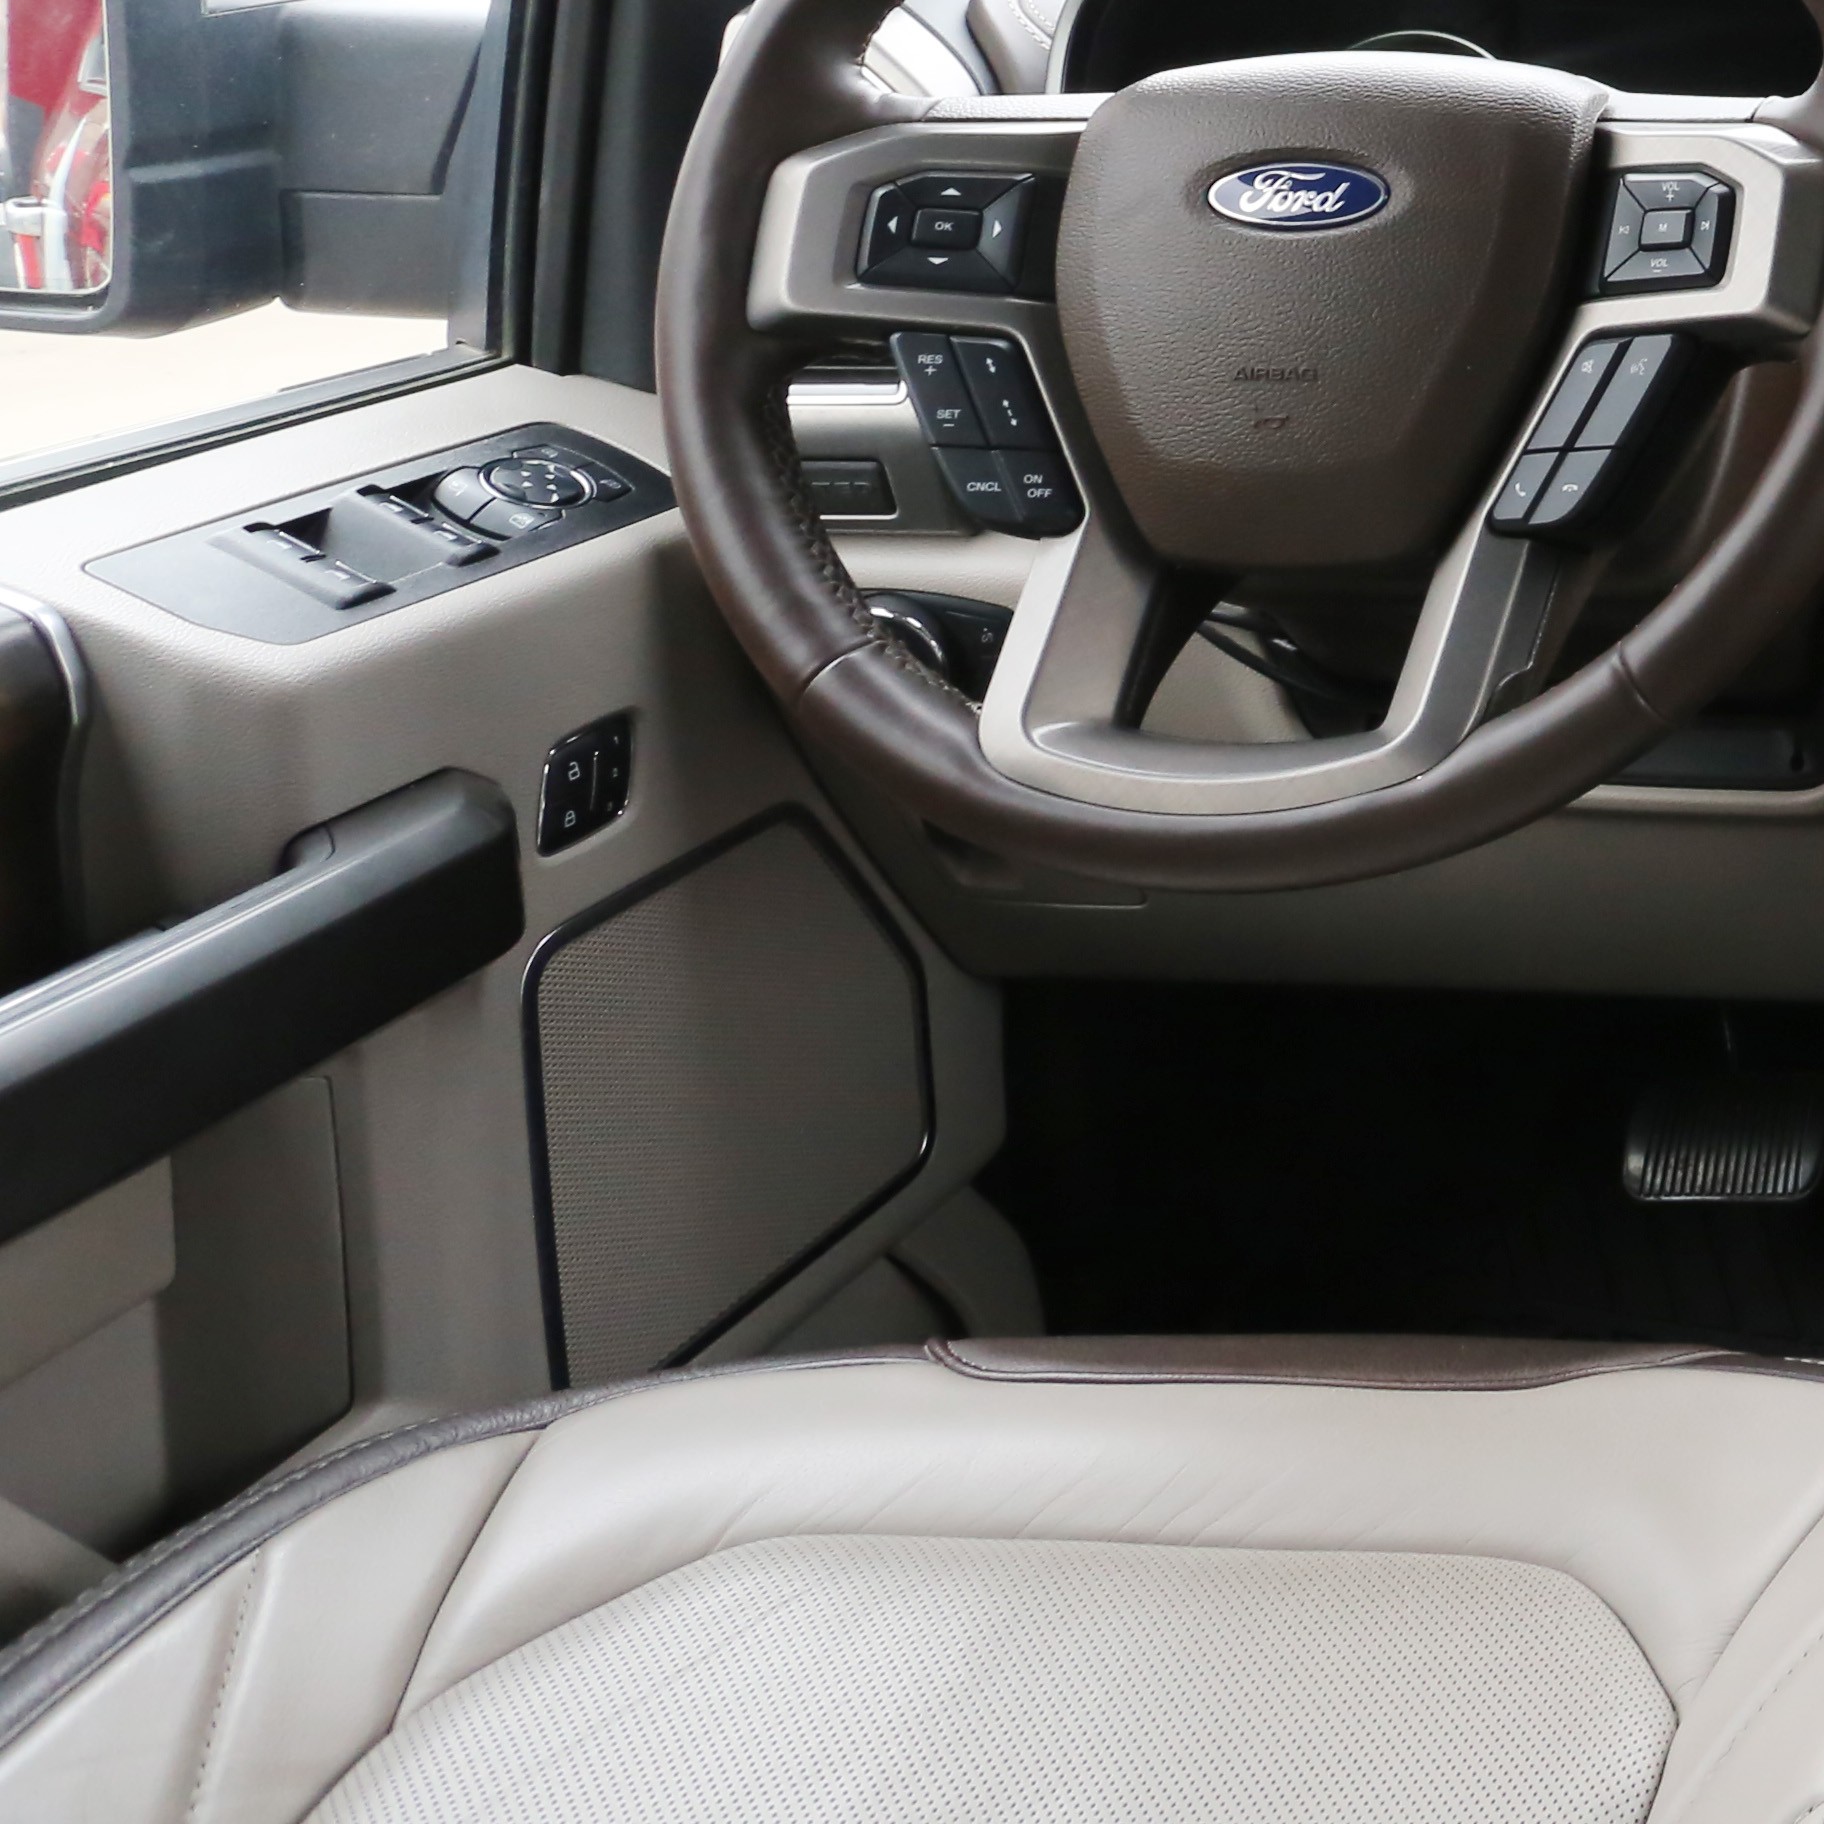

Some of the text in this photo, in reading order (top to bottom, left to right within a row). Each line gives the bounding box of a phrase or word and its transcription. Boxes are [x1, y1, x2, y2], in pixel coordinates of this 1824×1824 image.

[1238, 169, 1350, 213] Ford
[1661, 181, 1681, 191] VOL
[934, 221, 954, 232] OK
[1649, 258, 1669, 268] VOL
[917, 354, 943, 365] RES
[1233, 366, 1319, 382] AIRBAG
[936, 408, 961, 420] SET
[1023, 474, 1043, 485] ON
[966, 481, 1002, 493] CNCL
[1026, 487, 1053, 499] OFF
